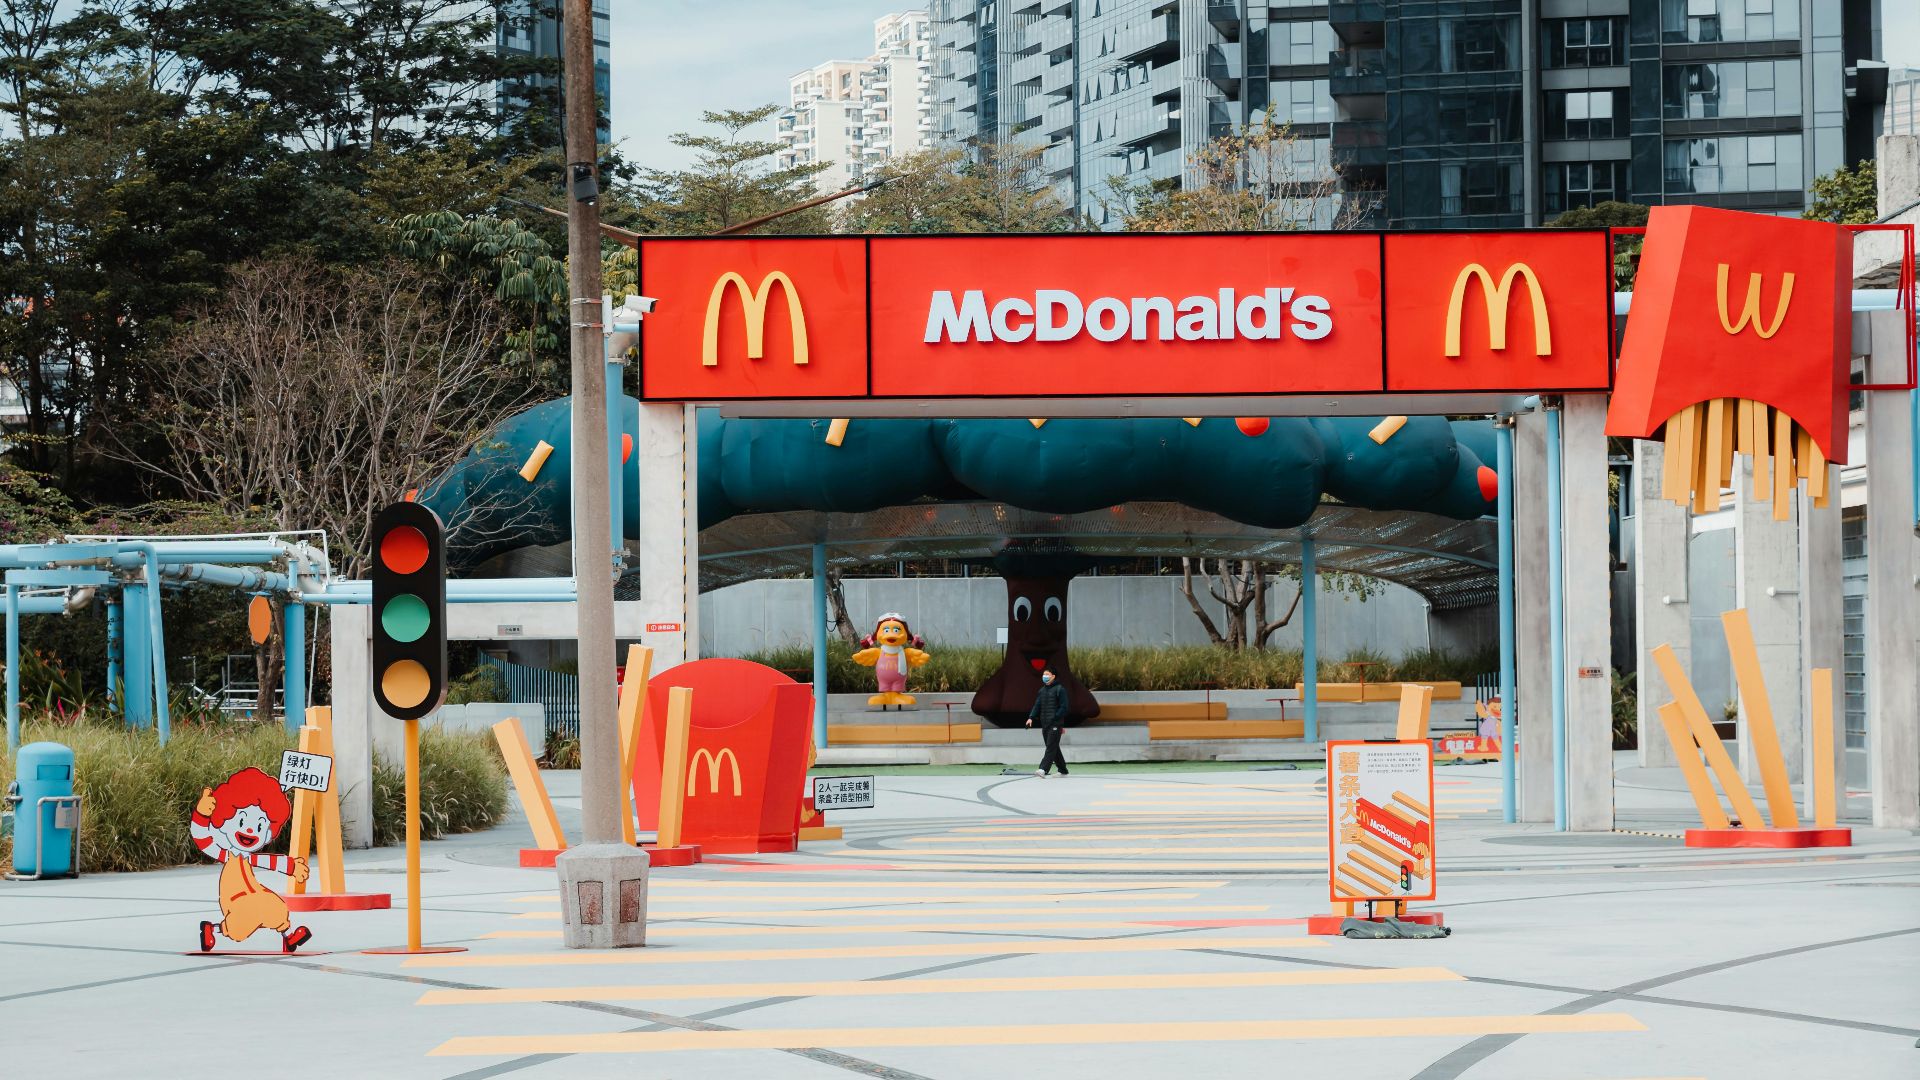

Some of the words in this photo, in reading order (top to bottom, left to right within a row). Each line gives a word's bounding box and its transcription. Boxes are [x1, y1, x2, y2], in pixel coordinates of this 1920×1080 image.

[924, 288, 1332, 343] McDonald's
[287, 755, 311, 769] 绿灯
[285, 770, 324, 787] 行快D!
[818, 792, 870, 804] 条盒子造型拍照
[1370, 819, 1411, 848] McDonald's
